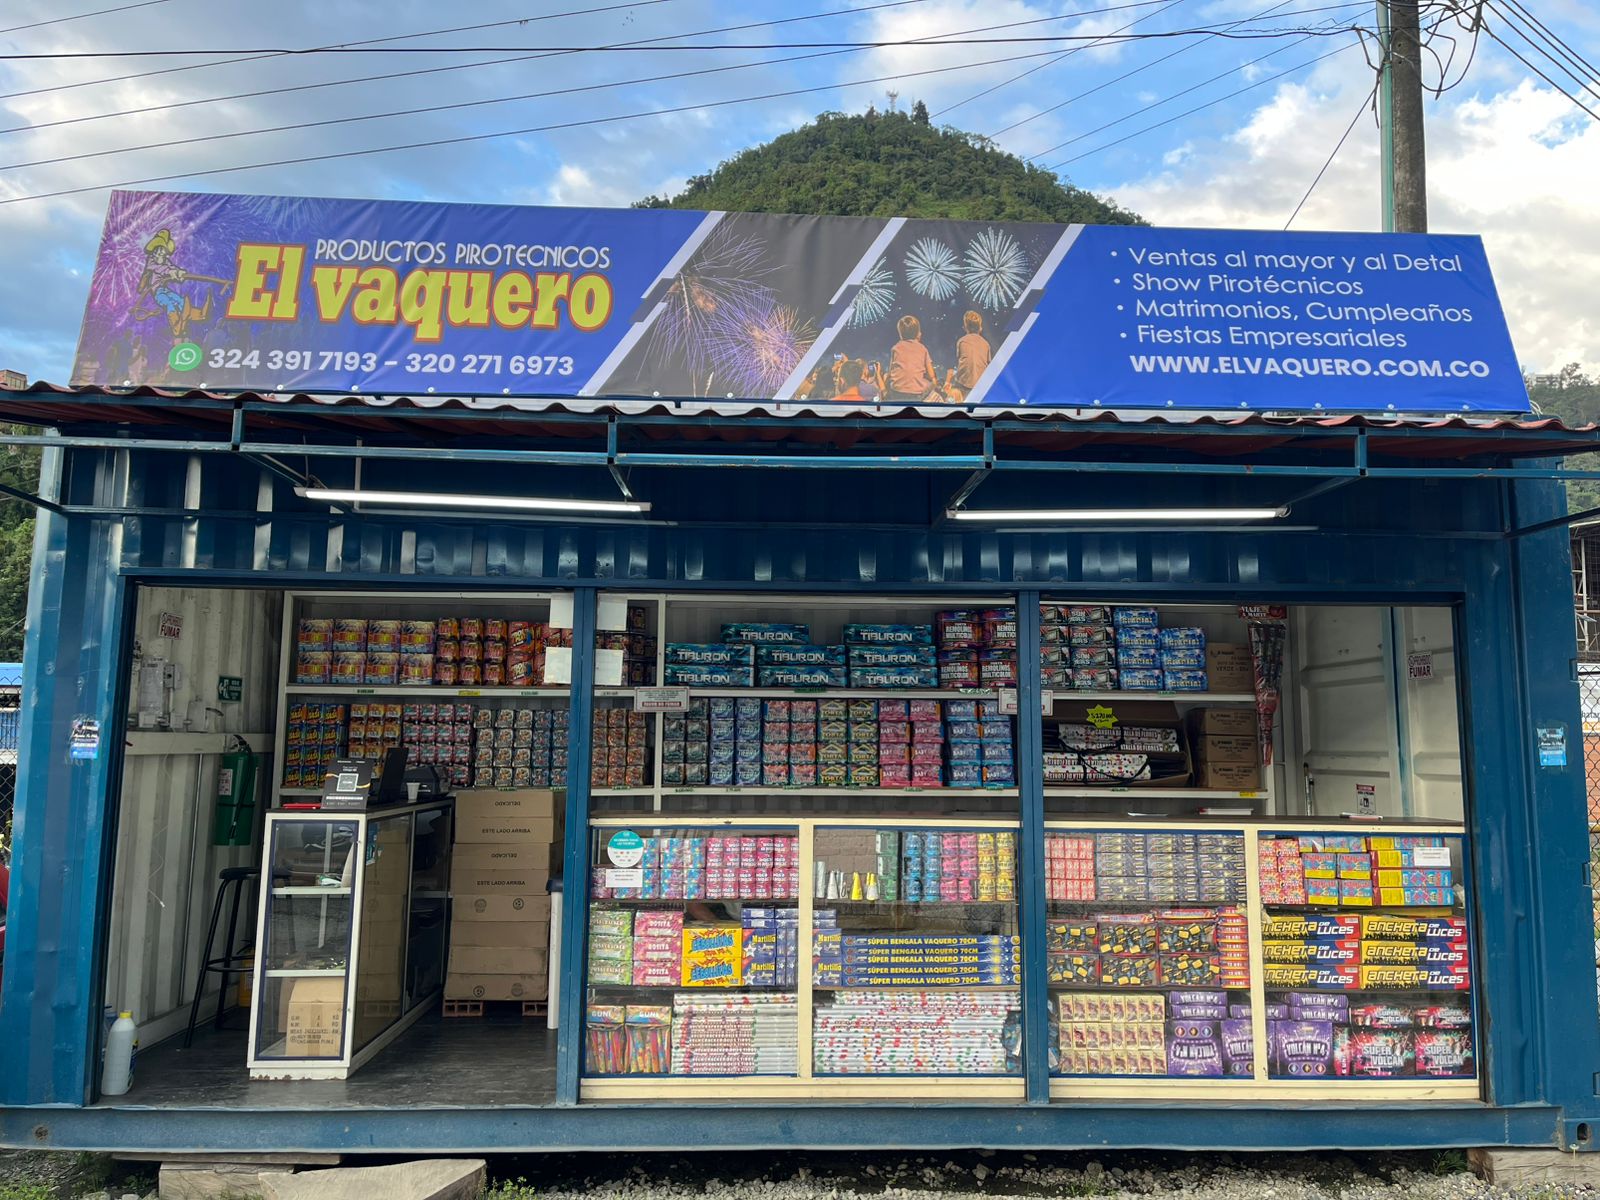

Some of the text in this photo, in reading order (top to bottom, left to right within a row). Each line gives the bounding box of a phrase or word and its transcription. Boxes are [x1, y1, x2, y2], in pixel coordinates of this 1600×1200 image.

[314, 238, 611, 269] PRODUCTOS PIROTECNICOS
[1129, 247, 1462, 273] Ventas al mayor y al Detal
[1133, 272, 1364, 295] Show Pirotécnicos
[227, 244, 613, 342] El vaquero
[1136, 299, 1473, 325] Matrimonios, Cumpleaños
[1137, 325, 1407, 350] Fiestas Empresariales
[208, 347, 260, 371] 324
[266, 349, 312, 373] 391
[320, 351, 377, 374] 7193
[405, 352, 457, 374] 320
[462, 353, 503, 375] 271
[510, 355, 575, 376] 6973
[1130, 355, 1490, 378] WWW.ELVAQUERO.COM.CO
[160, 624, 180, 639] FUMAR
[1409, 666, 1432, 677] FUMAR
[1317, 926, 1354, 935] LUCES
[1426, 928, 1462, 937] LUCES
[752, 935, 776, 943] Martillo
[818, 934, 842, 943] Martillo
[1317, 950, 1354, 959] LUCES
[1427, 952, 1463, 960] LUCES
[751, 963, 775, 971] Martillo
[818, 963, 842, 971] Martillo
[1264, 970, 1318, 979] NCHETA
[1317, 975, 1353, 984] LUCES
[1427, 976, 1463, 984] LUCES
[1363, 1046, 1392, 1055] SUPER
[1424, 1046, 1453, 1055] SUPER
[1371, 1056, 1404, 1066] VOLCAN
[1432, 1056, 1464, 1066] VOLCAN
